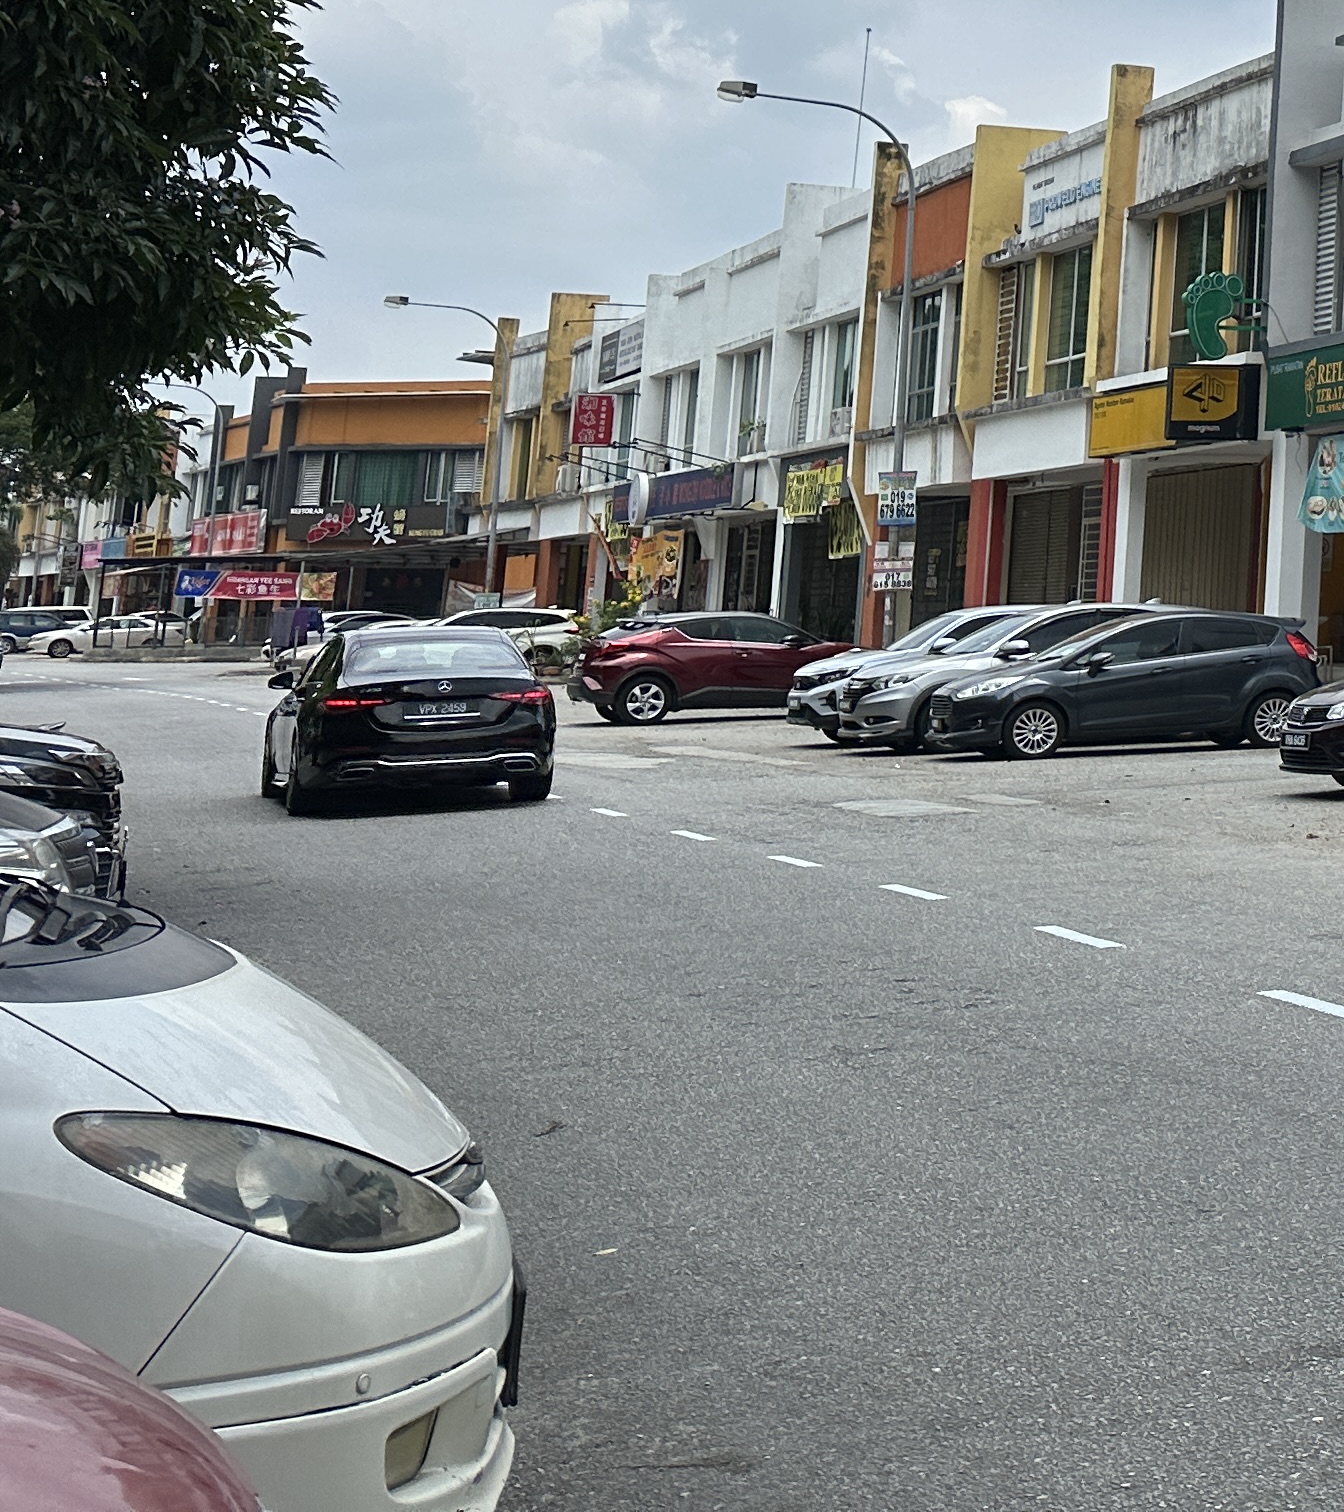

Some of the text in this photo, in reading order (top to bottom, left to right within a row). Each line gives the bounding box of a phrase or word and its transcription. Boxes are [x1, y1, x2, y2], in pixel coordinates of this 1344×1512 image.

[890, 490, 906, 504] 019
[880, 502, 915, 519] 679 6622
